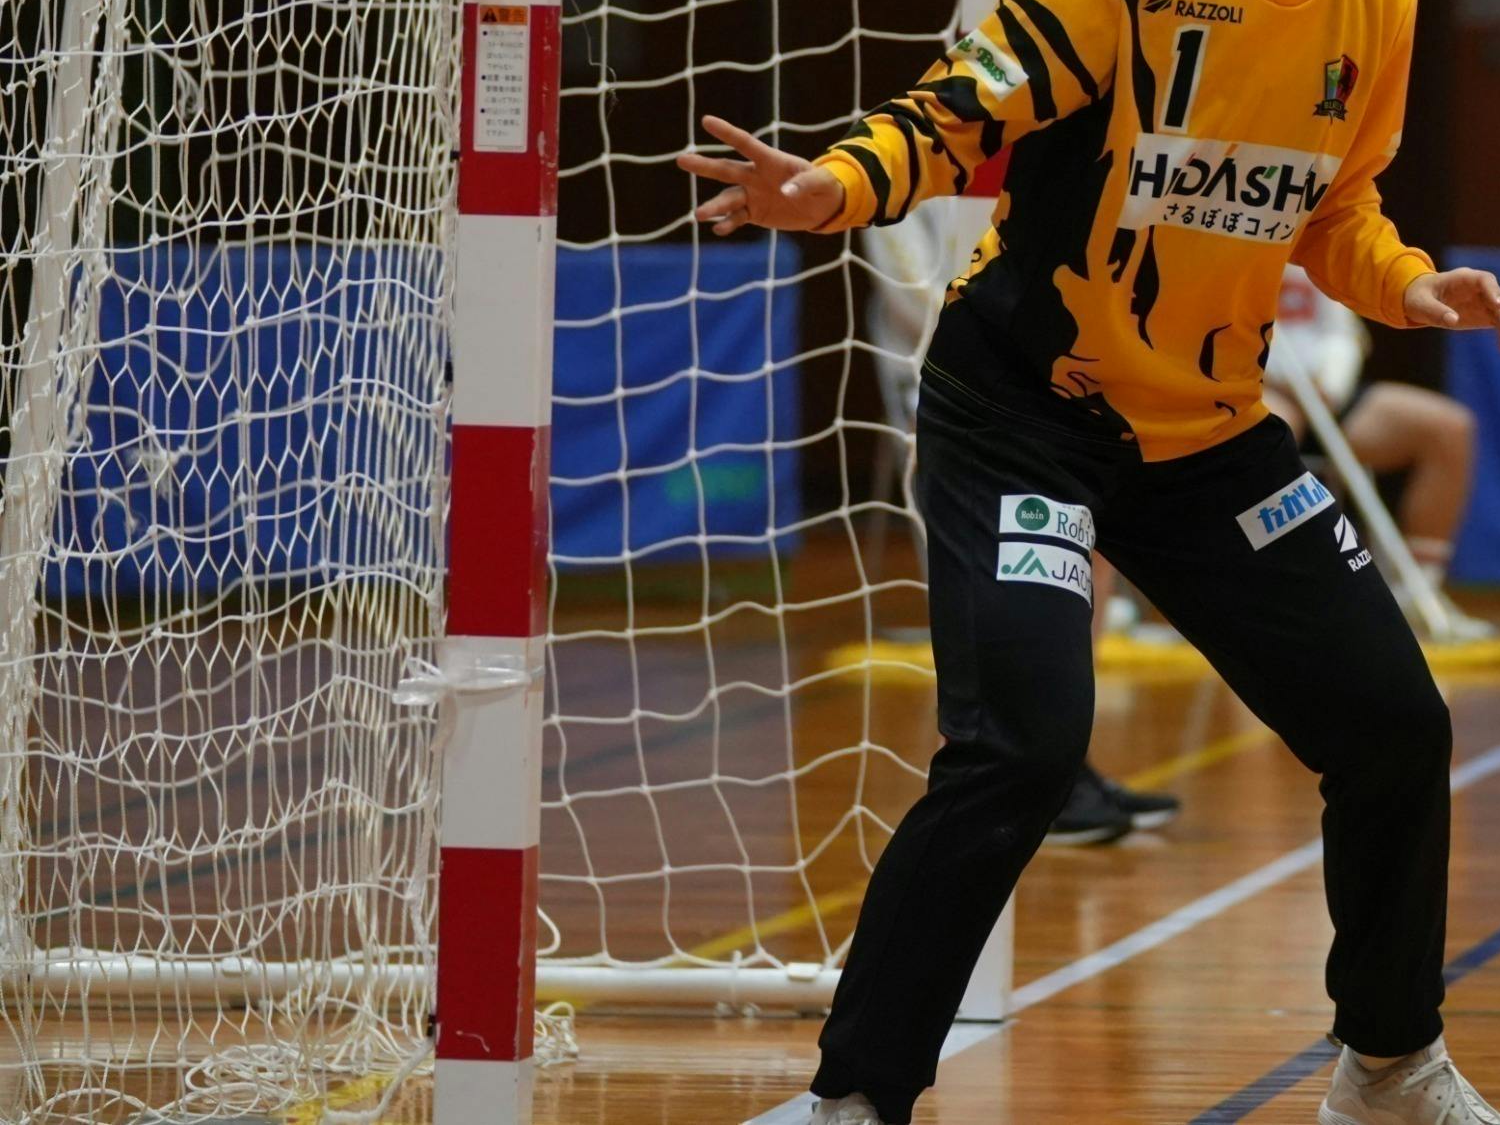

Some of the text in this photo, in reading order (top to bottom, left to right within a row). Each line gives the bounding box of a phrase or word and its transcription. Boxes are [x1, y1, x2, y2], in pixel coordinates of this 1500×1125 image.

[1175, 0, 1244, 24] RAZZOLI
[1159, 23, 1212, 135] 1
[1162, 202, 1297, 241] さるぼぼコイン
[1021, 509, 1044, 521] Robin
